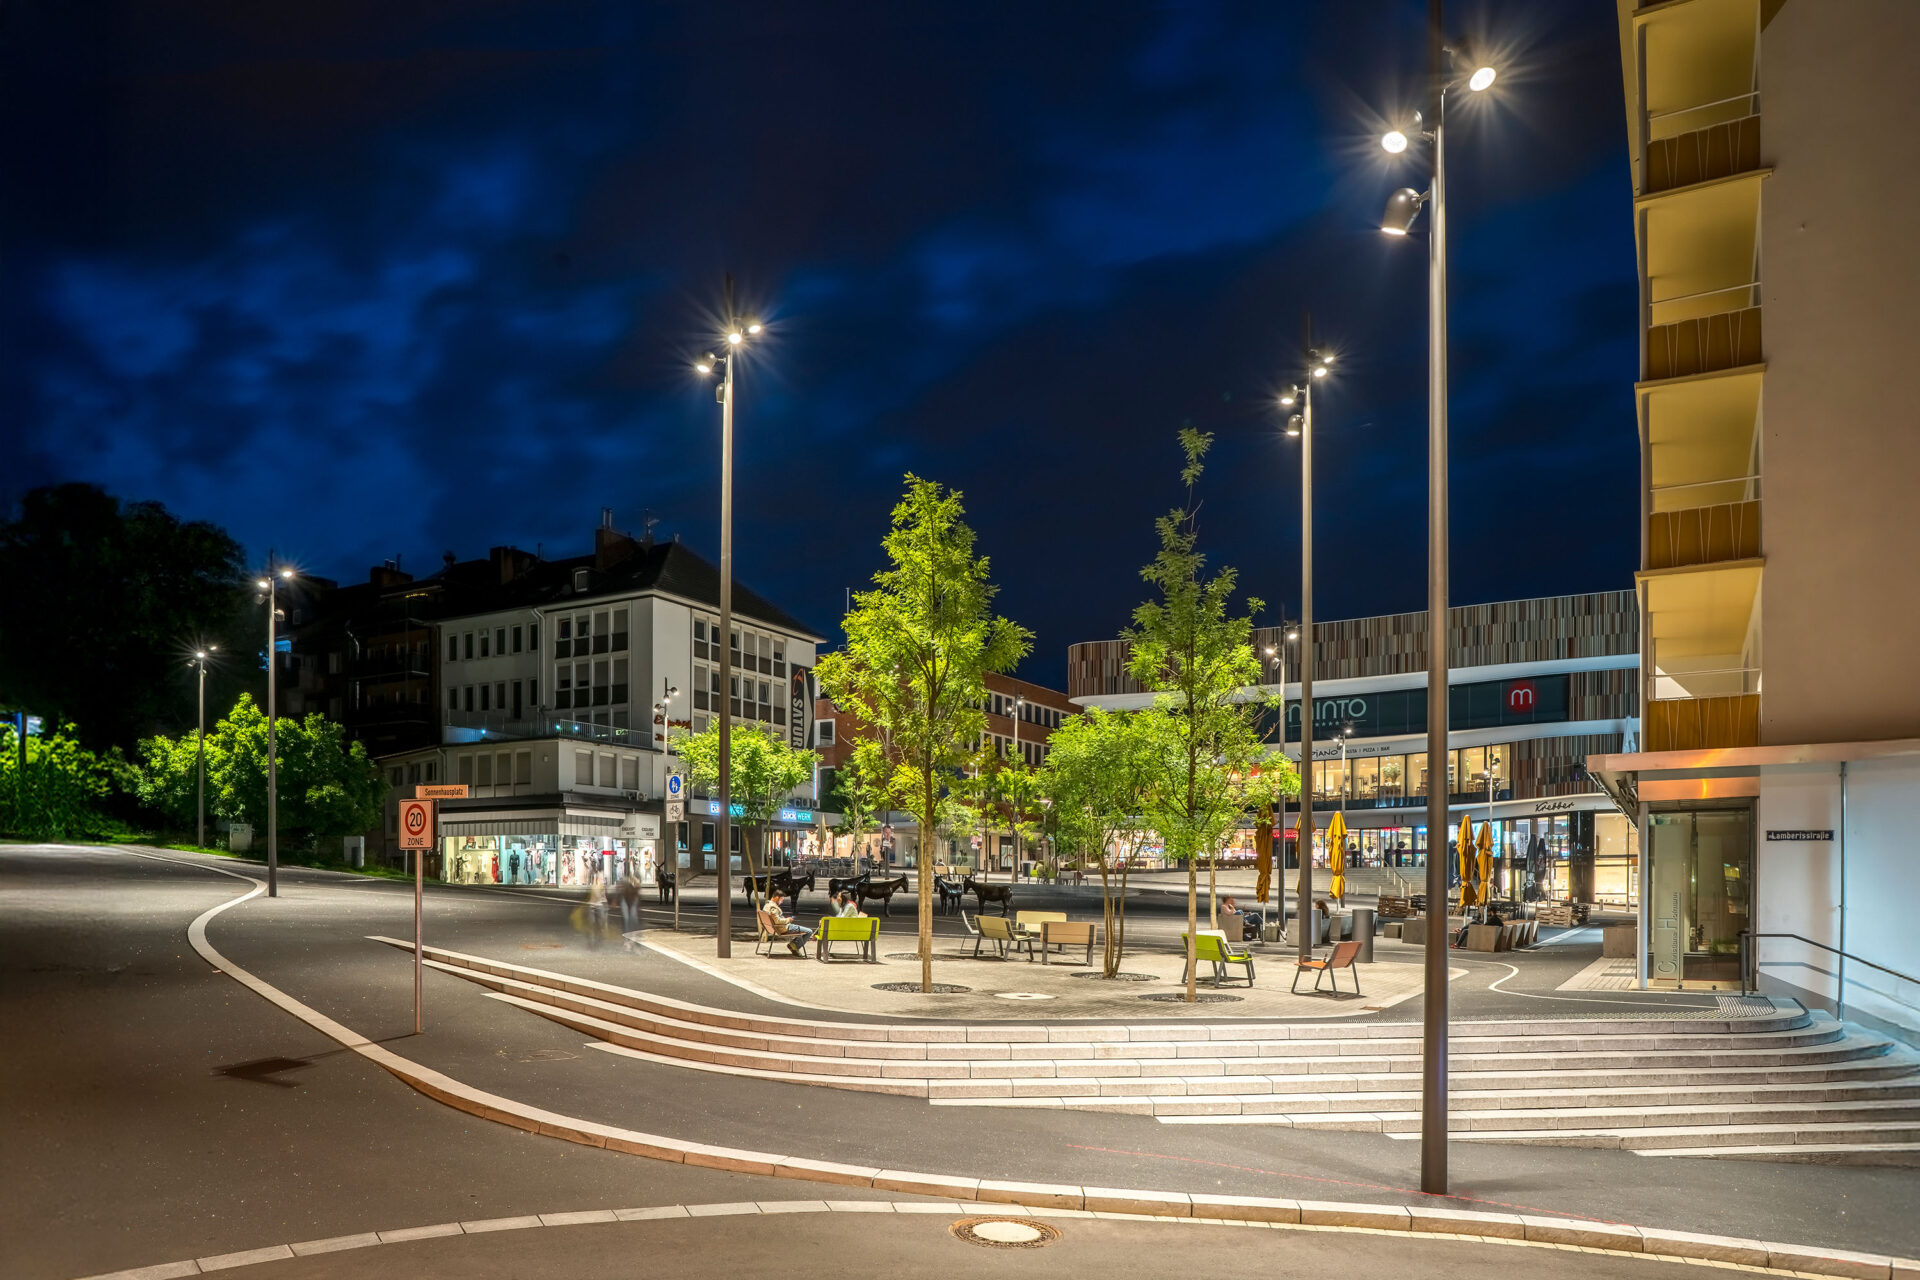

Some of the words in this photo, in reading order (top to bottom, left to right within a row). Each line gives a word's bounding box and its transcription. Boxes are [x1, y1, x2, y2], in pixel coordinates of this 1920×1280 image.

[424, 787, 464, 797] Sonnenhausplatz
[409, 812, 422, 827] 20
[407, 837, 424, 846] ZONE
